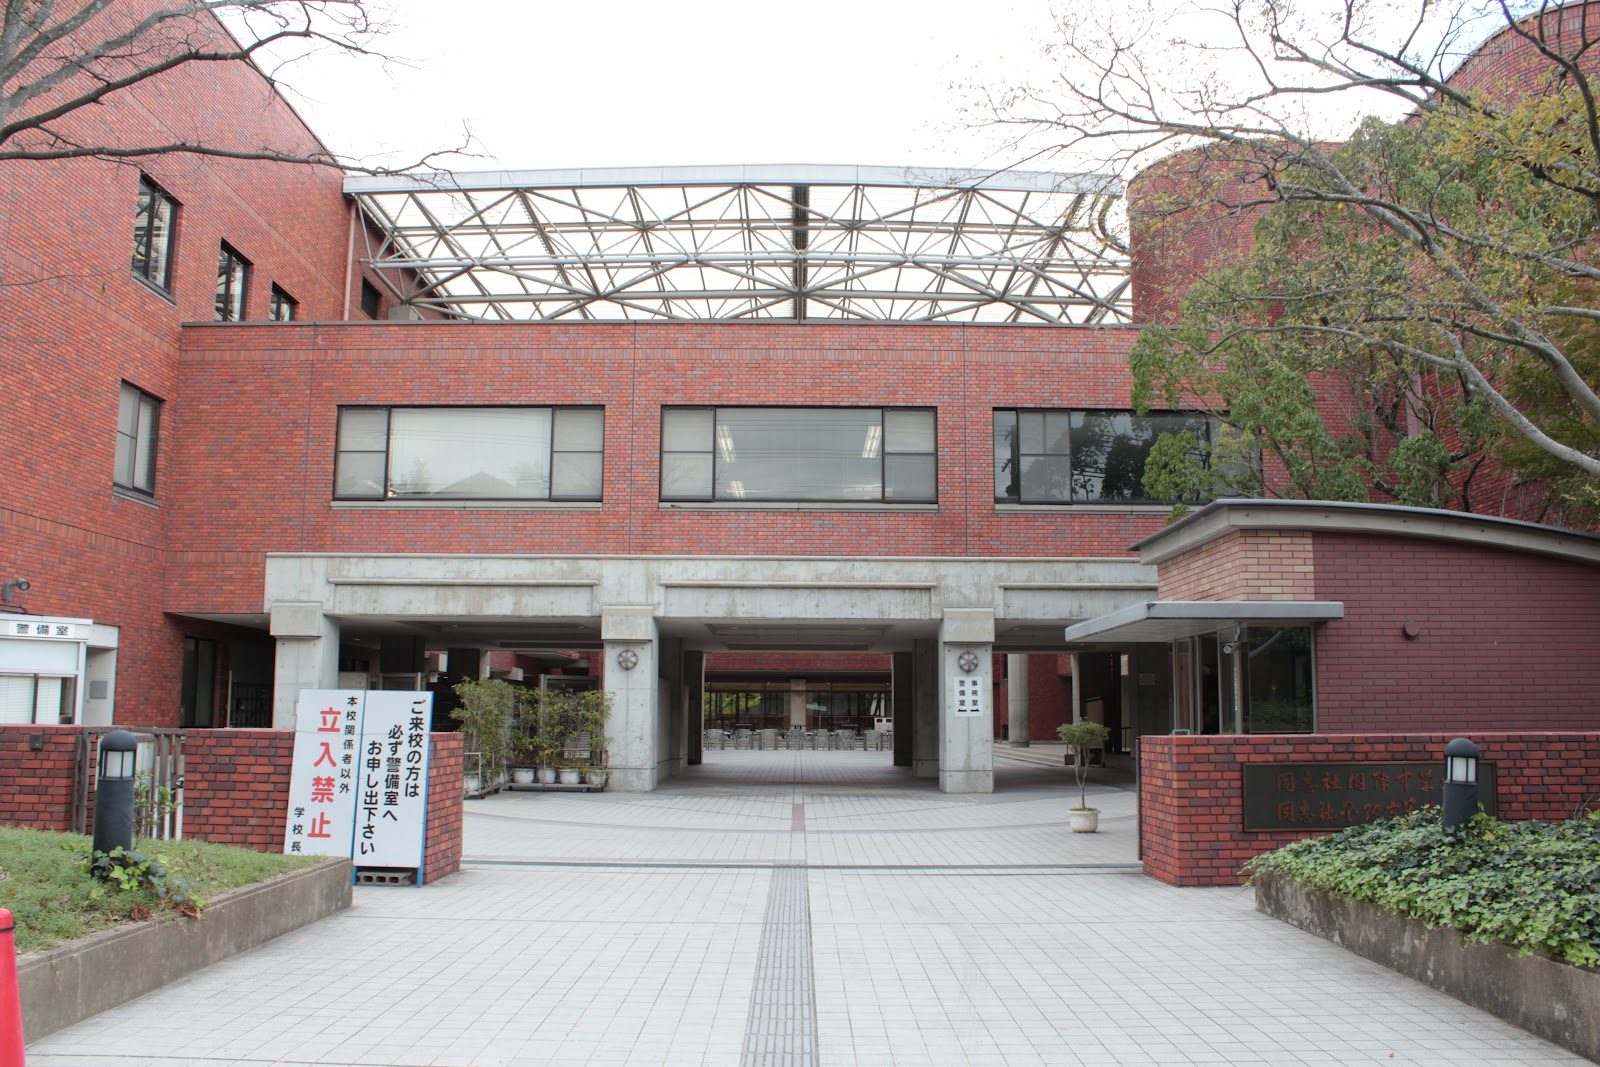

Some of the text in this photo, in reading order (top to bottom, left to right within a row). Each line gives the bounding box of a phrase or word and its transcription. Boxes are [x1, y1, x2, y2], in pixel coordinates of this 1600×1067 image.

[16, 623, 69, 636] 警備室
[307, 707, 342, 839] 立入禁止
[339, 696, 358, 794] 本校関係者以外
[382, 724, 404, 822] 必ず警備室へ
[405, 699, 427, 798] ご来校の方は
[291, 806, 305, 852] 学校長
[361, 740, 383, 855] お申し出下さい
